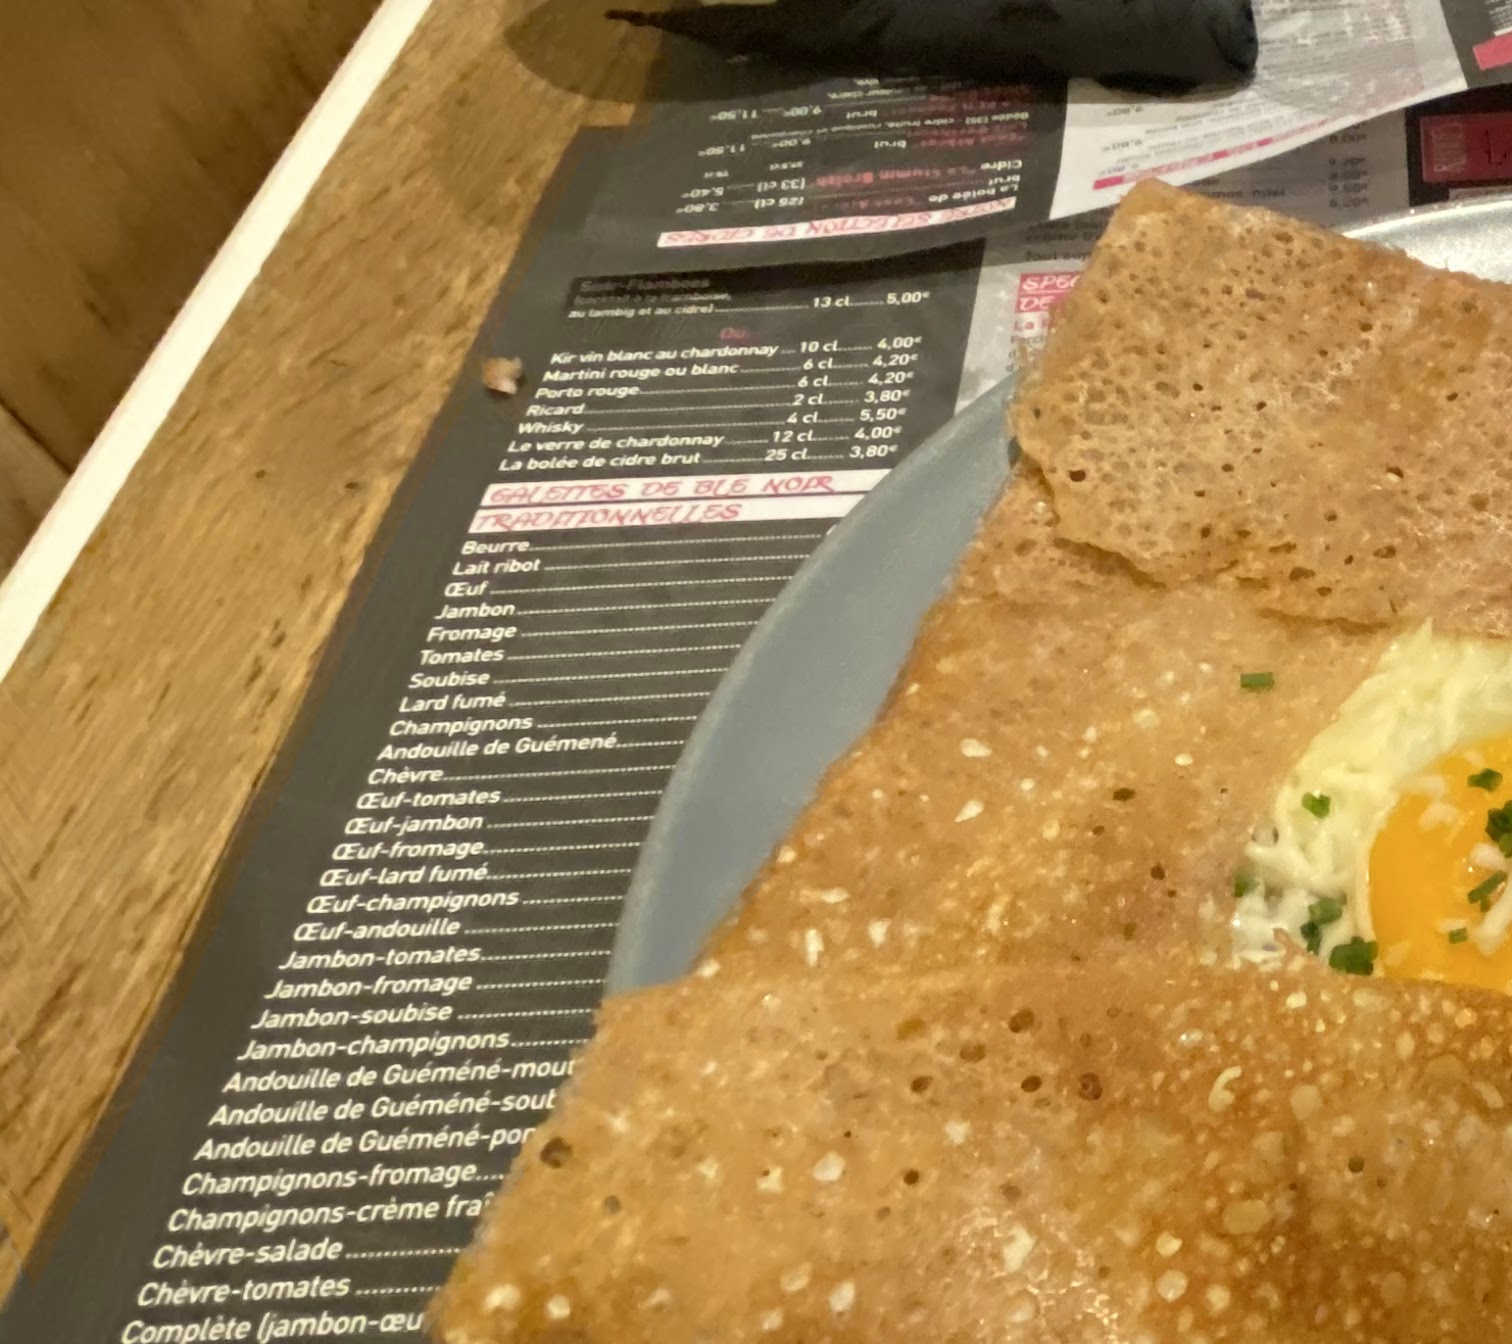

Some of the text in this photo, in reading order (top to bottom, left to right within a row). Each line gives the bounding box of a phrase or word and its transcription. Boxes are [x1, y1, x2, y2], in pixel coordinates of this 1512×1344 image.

[813, 291, 930, 308] 13 cl 5,00€
[551, 336, 922, 364] Kir vin blanc au chardonnay 10 cl 4,00€
[543, 354, 918, 381] Martini rouge ou blanc 6 cl 4,20€
[536, 372, 914, 398] Porto rouge 6 cl 4,20€
[526, 389, 910, 416] Ricard 2 cl 3,80€
[518, 408, 907, 435] Whisky 4 cl 5,50€
[508, 426, 902, 452] Le verre de chardonnay 12 cl 4,00€
[499, 445, 898, 471] La bolée de cidre brut 25 cl 3,80€
[489, 475, 835, 503] GALETTES DE NOIR
[475, 504, 742, 531] TRADITIONNELLES
[461, 540, 529, 555] Beurre
[453, 559, 540, 575] Lait ribot
[445, 582, 486, 597] Œuf
[435, 602, 515, 620] Jambon
[427, 624, 517, 643] Fromage
[420, 647, 504, 666] Tomates
[409, 670, 489, 689] Soubise
[399, 691, 506, 714] Lard fumé
[389, 715, 533, 738] Champignons
[377, 742, 478, 762] Andouille
[484, 738, 509, 755] de
[368, 766, 444, 785] Chèvre
[356, 789, 501, 810] Œuf-tomates
[345, 814, 484, 835] Œuf-jambon
[332, 839, 484, 861] Œuf-fromage
[319, 861, 488, 887] Œuf-lard fumé
[307, 890, 519, 913] Œuf-champignons
[294, 919, 460, 941] Œuf-andouille
[279, 946, 481, 970] Jambon-tomates
[264, 975, 473, 1000] Jambon-fromage
[251, 1003, 452, 1029] Jambon-soubise
[237, 1031, 510, 1060] Jambon-champignons
[222, 1070, 342, 1094] Andouille
[347, 1065, 377, 1088] de
[209, 1099, 365, 1127] Andouille de
[194, 1133, 352, 1160] Andouille de
[182, 1164, 477, 1196] Champignons-fromage
[168, 1198, 439, 1232] Champignons-crème
[152, 1239, 343, 1269] Chèvre-salade
[137, 1276, 350, 1307] Chèvre-tomates
